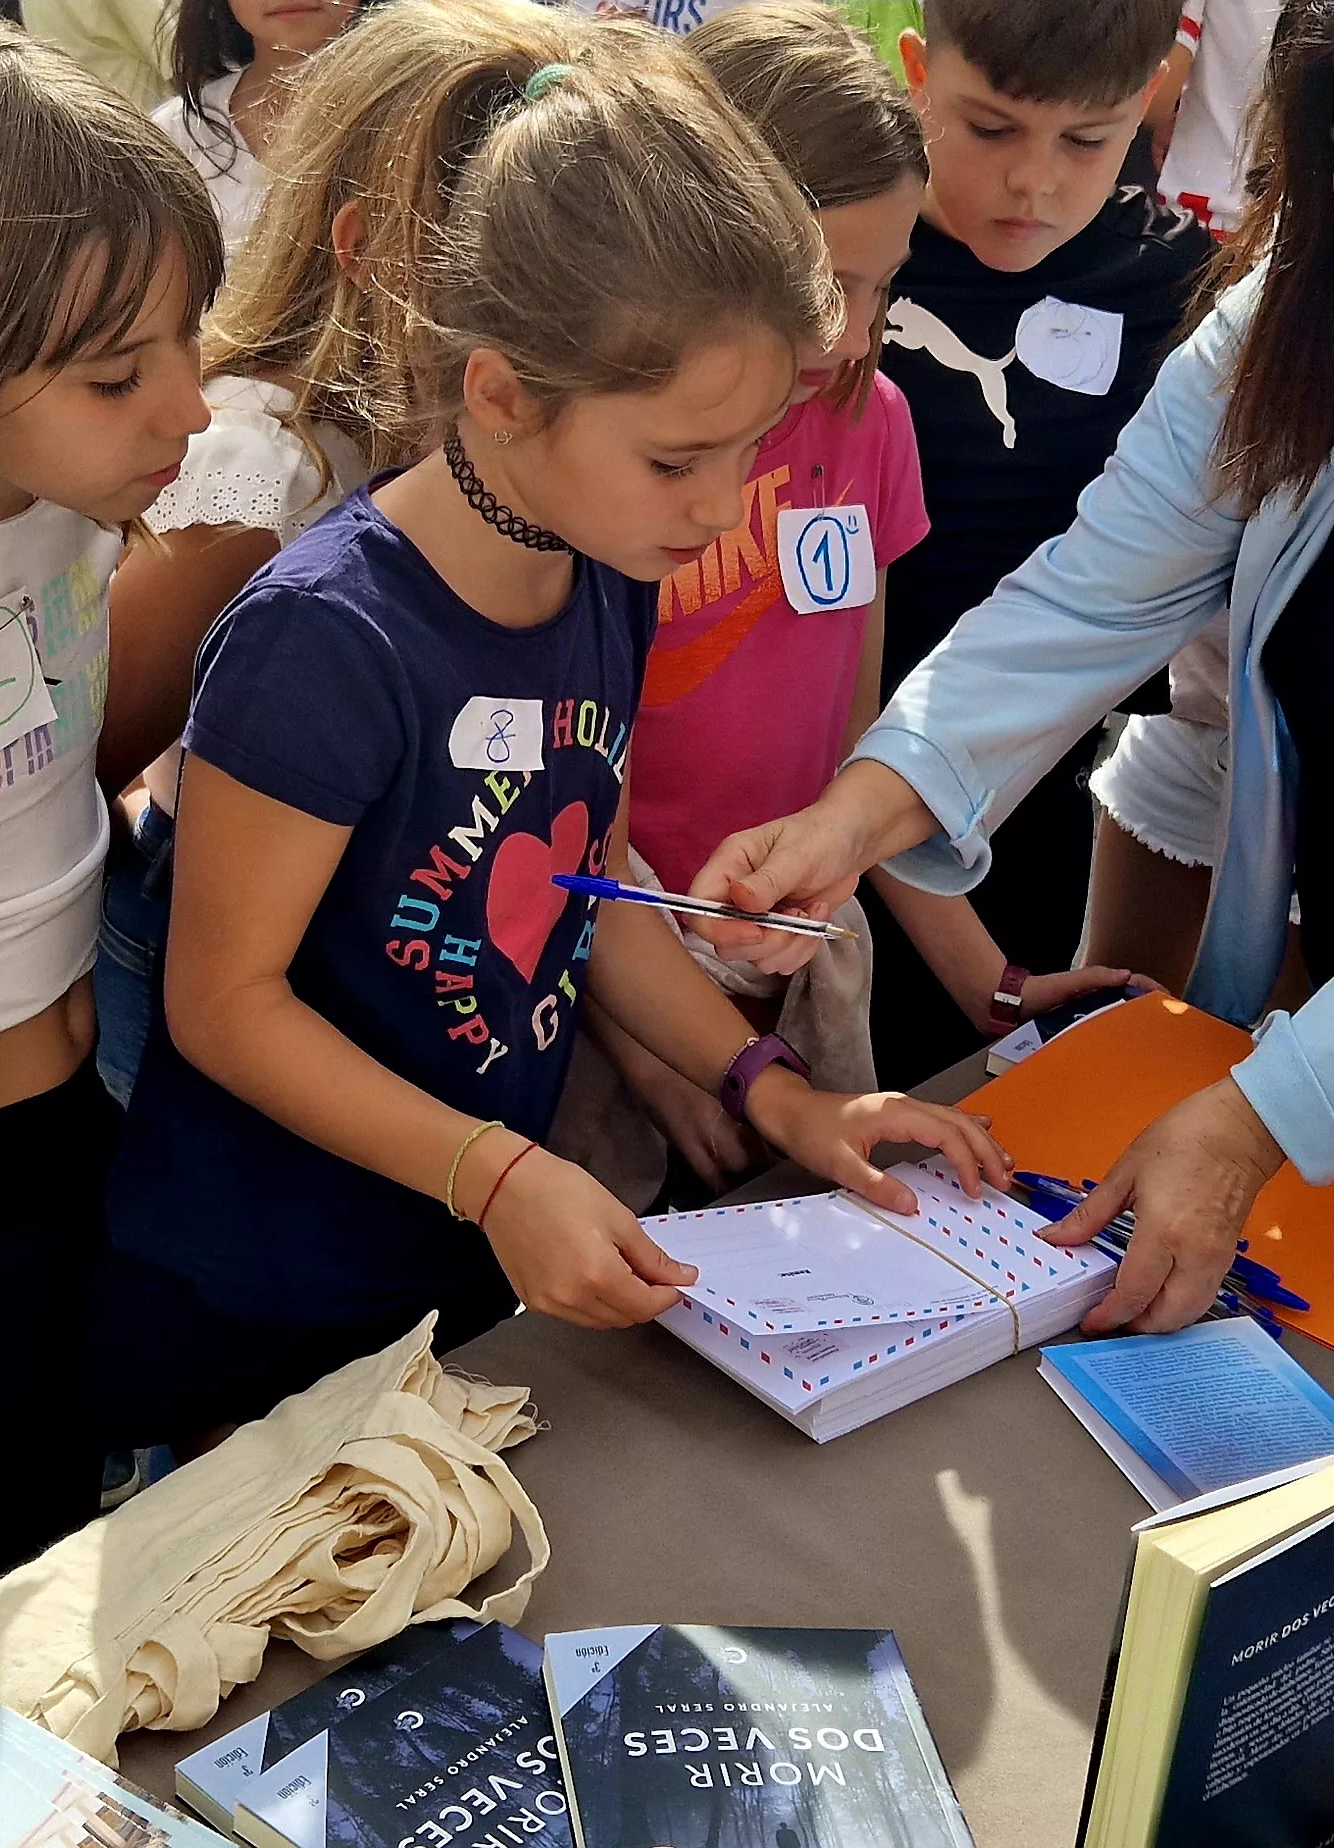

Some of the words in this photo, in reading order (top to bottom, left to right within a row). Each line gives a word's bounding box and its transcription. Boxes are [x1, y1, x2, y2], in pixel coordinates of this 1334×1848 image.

[812, 530, 834, 592] 1
[485, 708, 516, 763] 8
[435, 934, 508, 1075] HAPPY
[574, 1644, 610, 1659] Edición
[1231, 1632, 1279, 1667] MORIR
[1281, 1612, 1310, 1639] DOS
[654, 1703, 715, 1714] SERAL
[723, 1703, 834, 1714] ALEJANDRO
[447, 1715, 529, 1775] ALEJANDRO
[515, 1735, 559, 1776] OS
[623, 1727, 776, 1757] VECES
[787, 1727, 886, 1752] DOS
[214, 1746, 249, 1770] Edición
[683, 1761, 847, 1788] MORIR
[276, 1775, 312, 1800] Edición
[395, 1775, 445, 1811] SERAL
[471, 1779, 567, 1848] ORIR
